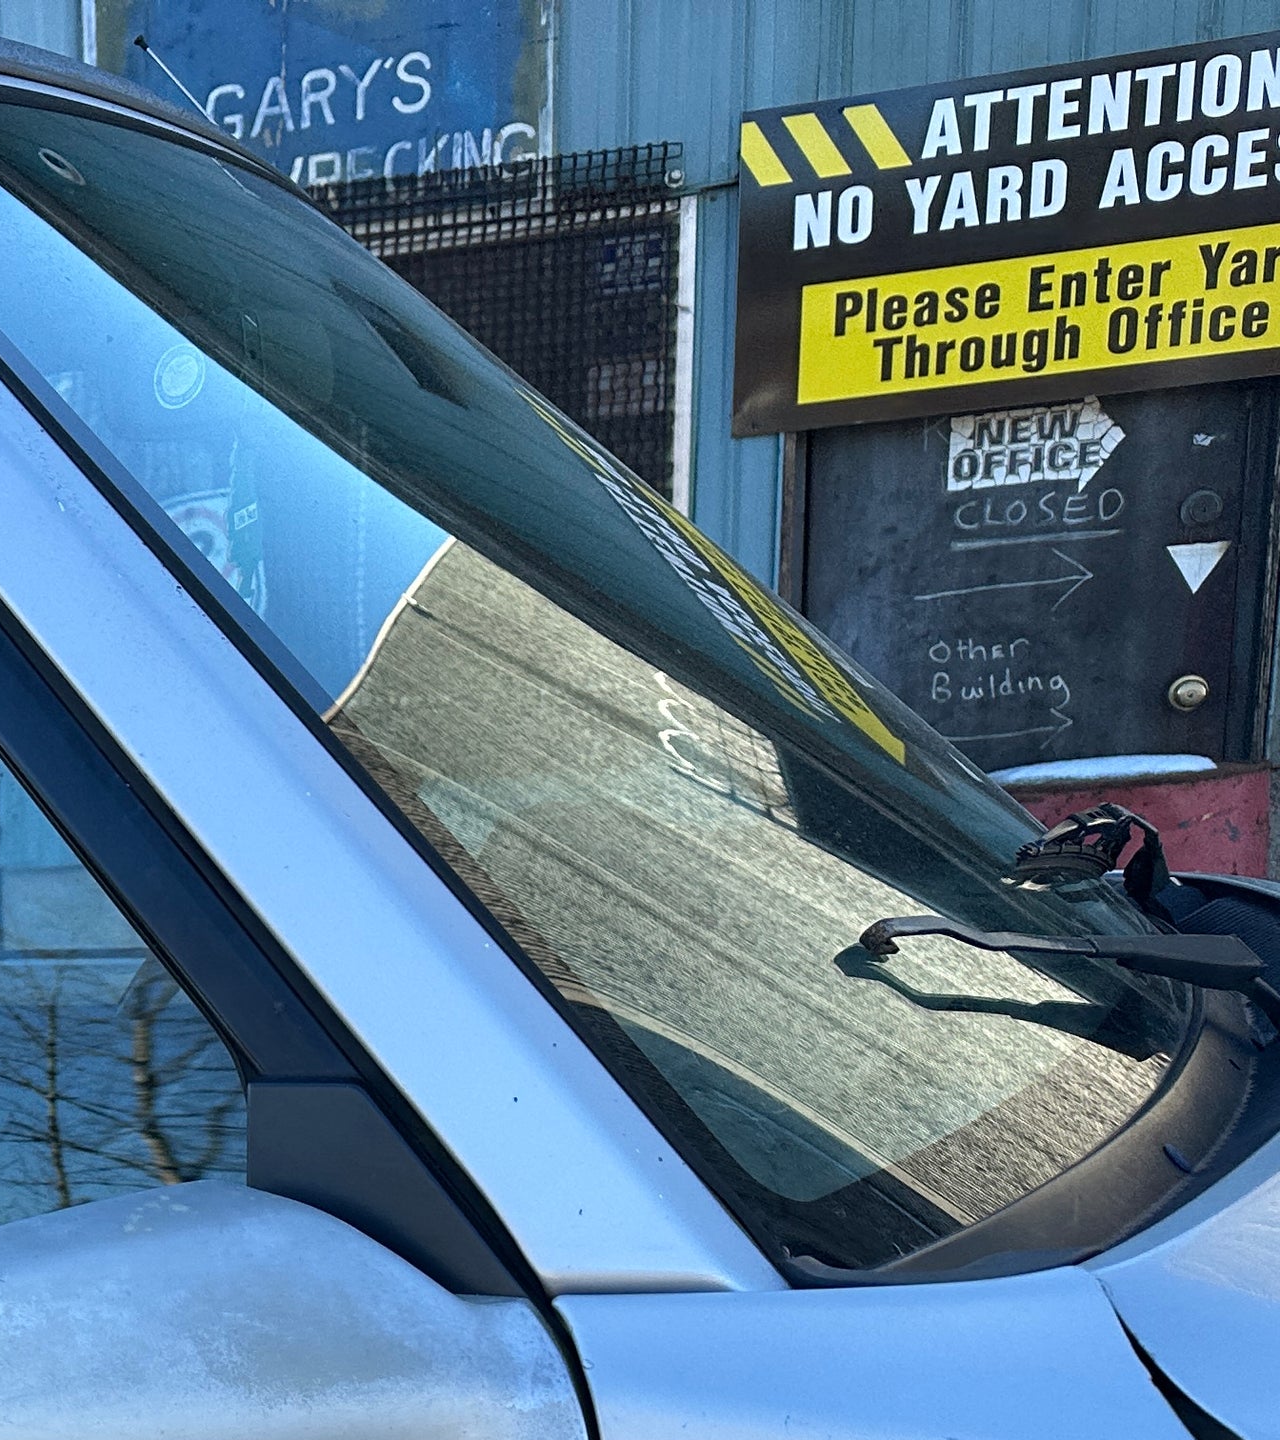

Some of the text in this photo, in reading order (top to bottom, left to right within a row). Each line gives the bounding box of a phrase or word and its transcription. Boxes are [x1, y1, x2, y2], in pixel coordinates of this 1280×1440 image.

[205, 51, 432, 139] GARY'S
[921, 47, 1280, 159] ATTENTION
[792, 127, 1280, 251] NO YARD ACCE
[834, 282, 1001, 337] Please
[1028, 257, 1172, 313] Enter
[873, 298, 1270, 382] Through Office
[952, 440, 1102, 482] OFFICE
[974, 411, 1079, 450] NEW
[954, 488, 1125, 529] CLOSED
[931, 668, 1071, 711] Building
